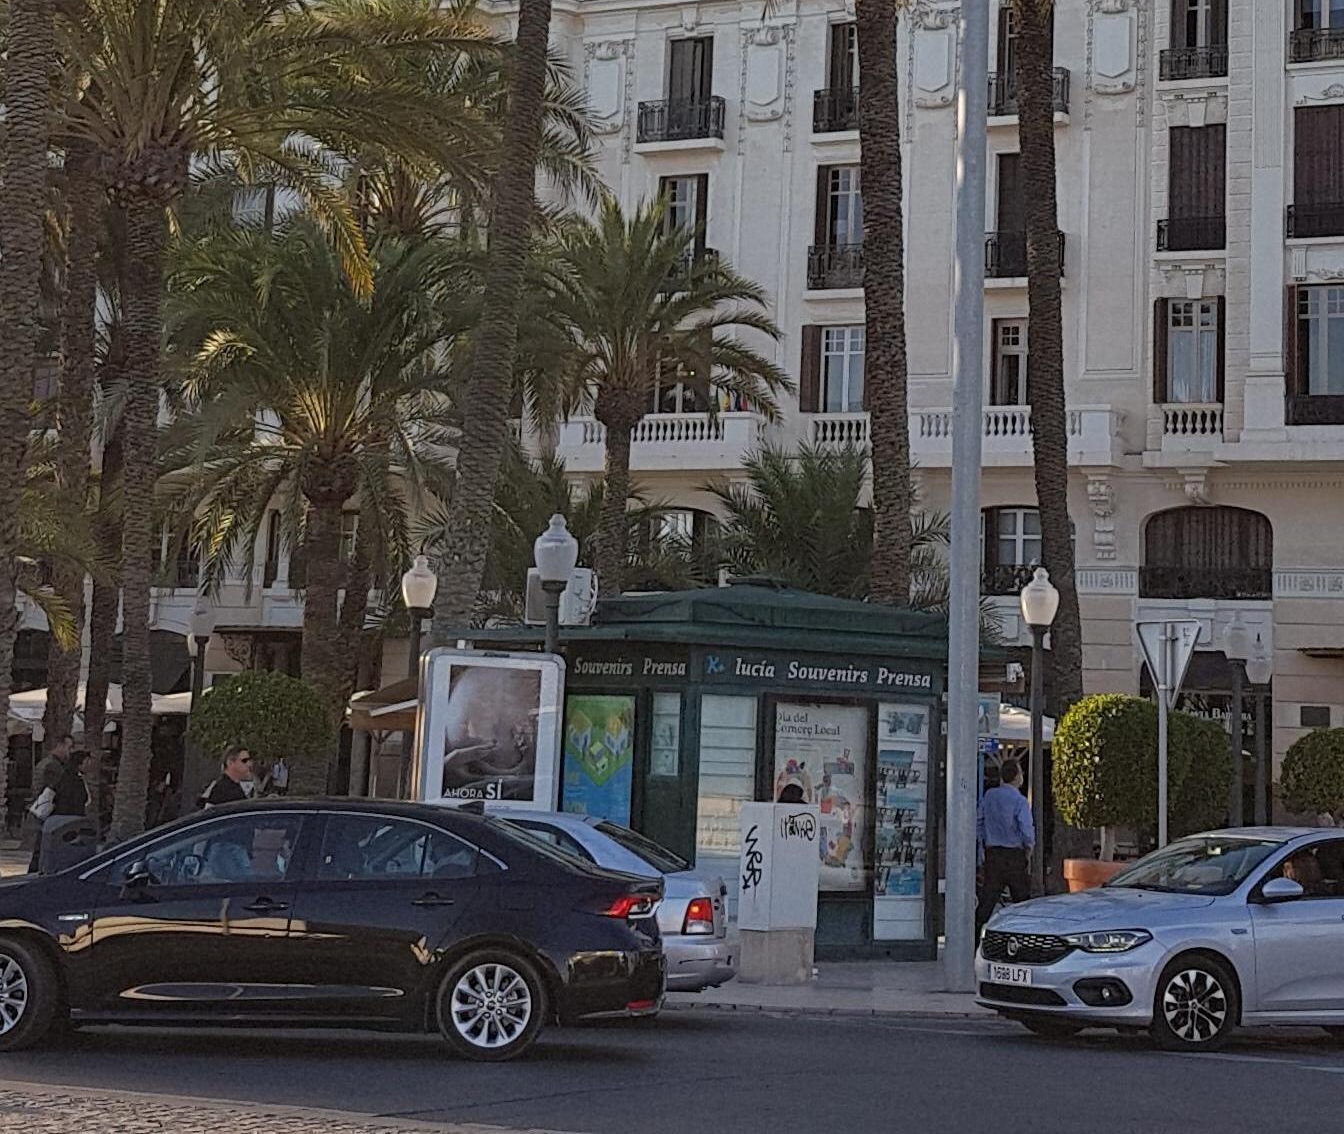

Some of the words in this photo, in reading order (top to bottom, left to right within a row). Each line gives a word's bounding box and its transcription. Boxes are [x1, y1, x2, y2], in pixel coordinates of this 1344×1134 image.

[574, 657, 633, 675] Souvenirs
[642, 657, 686, 675] Prensa
[735, 657, 775, 678] lucía
[788, 661, 868, 683] Souvenirs
[876, 667, 931, 688] Prensa
[815, 724, 840, 735] Local
[443, 787, 483, 799] AHORA
[486, 778, 503, 800] SÍ
